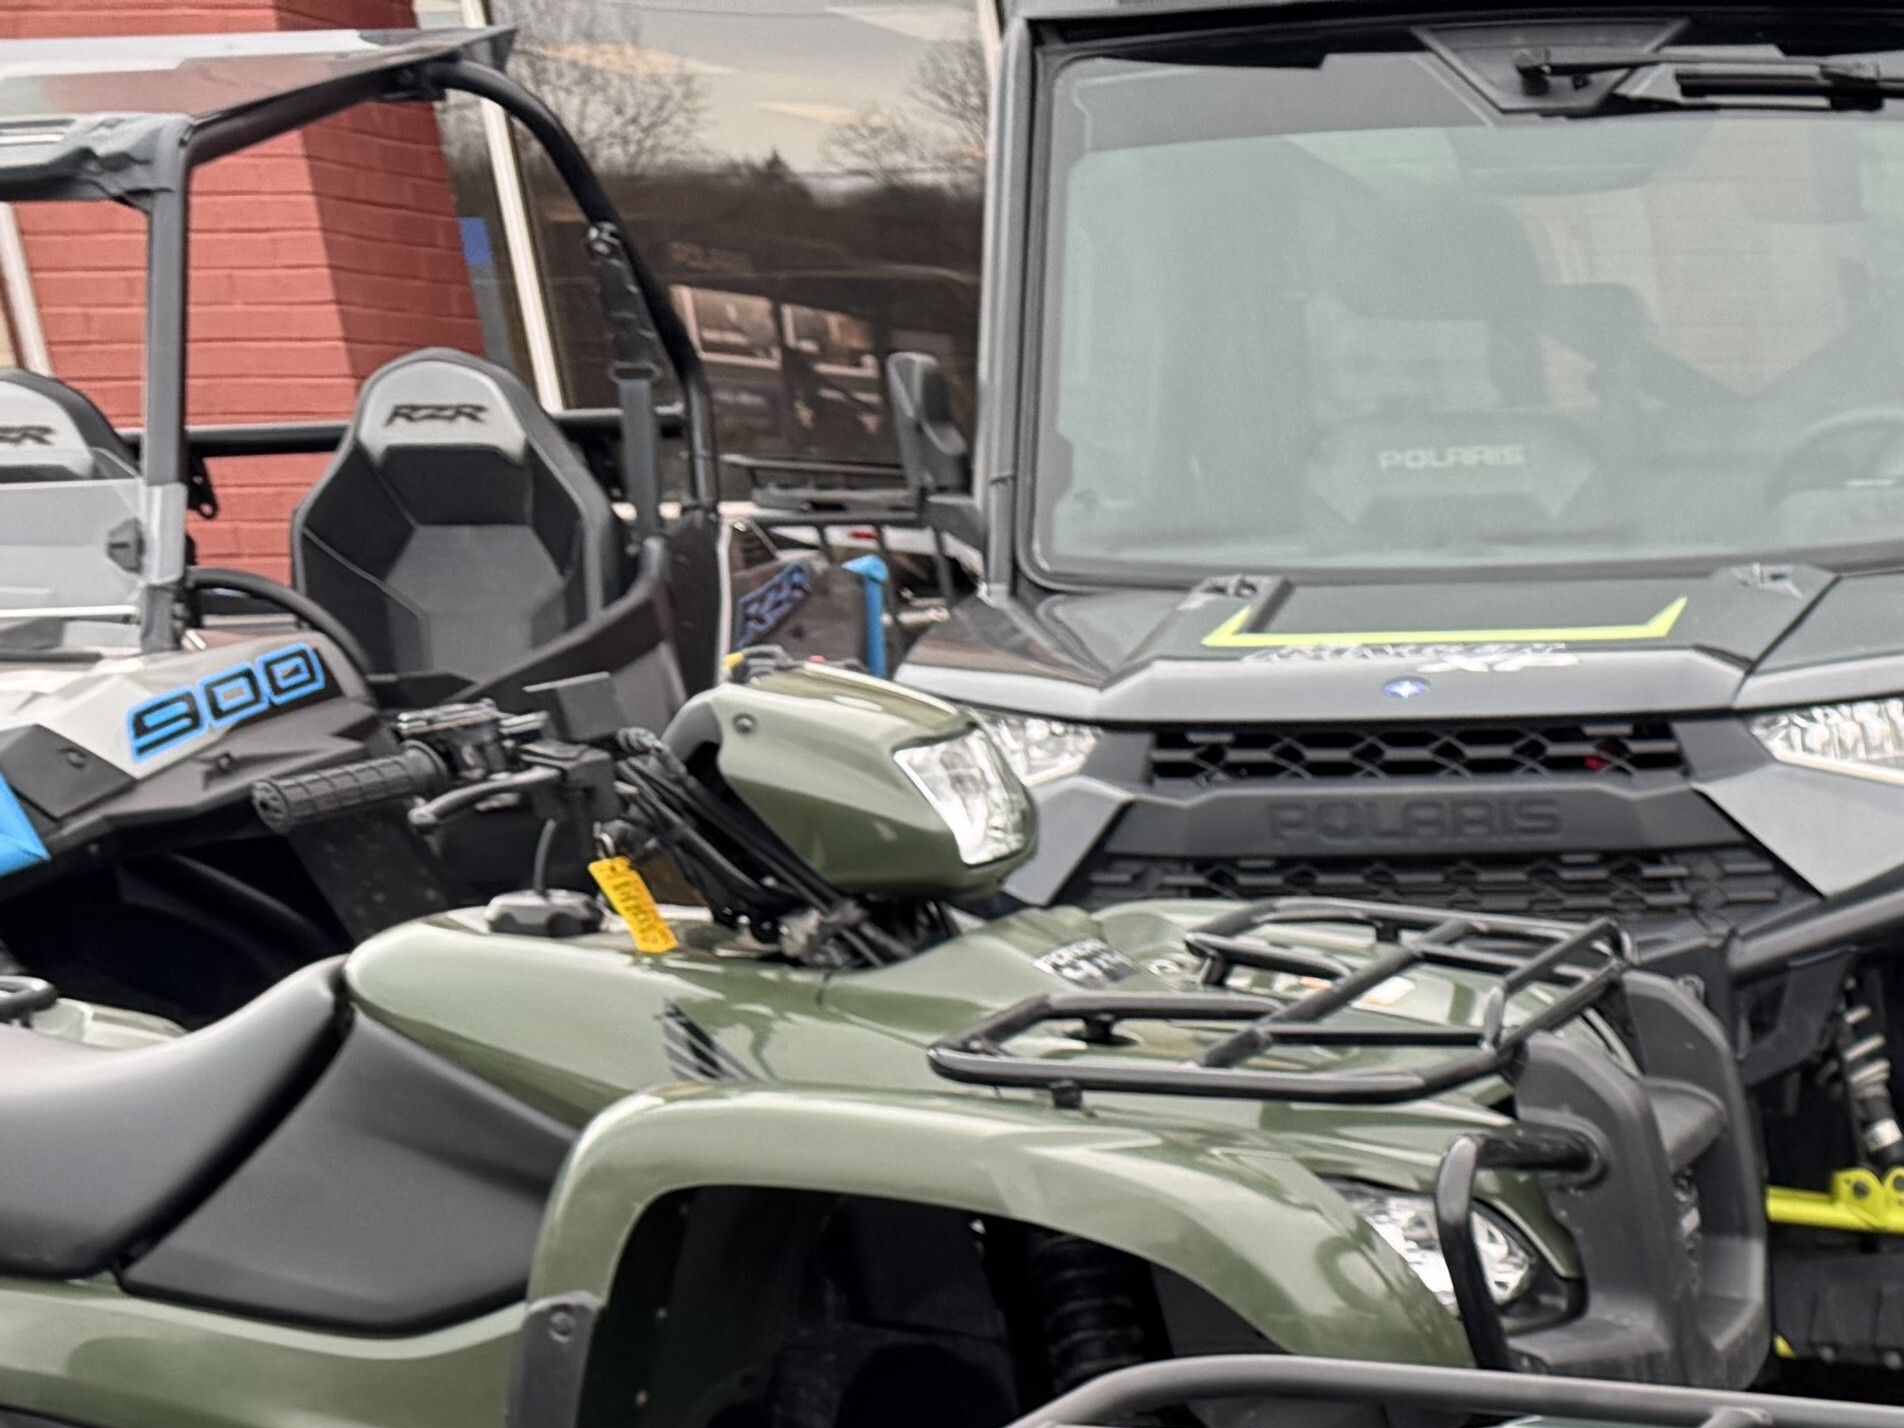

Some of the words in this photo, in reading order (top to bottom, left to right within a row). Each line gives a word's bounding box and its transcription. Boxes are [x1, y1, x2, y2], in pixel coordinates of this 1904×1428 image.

[386, 403, 489, 425] RZR
[1379, 444, 1524, 471] POLARIS
[127, 643, 326, 766] 900
[1266, 800, 1564, 847] POLARIS
